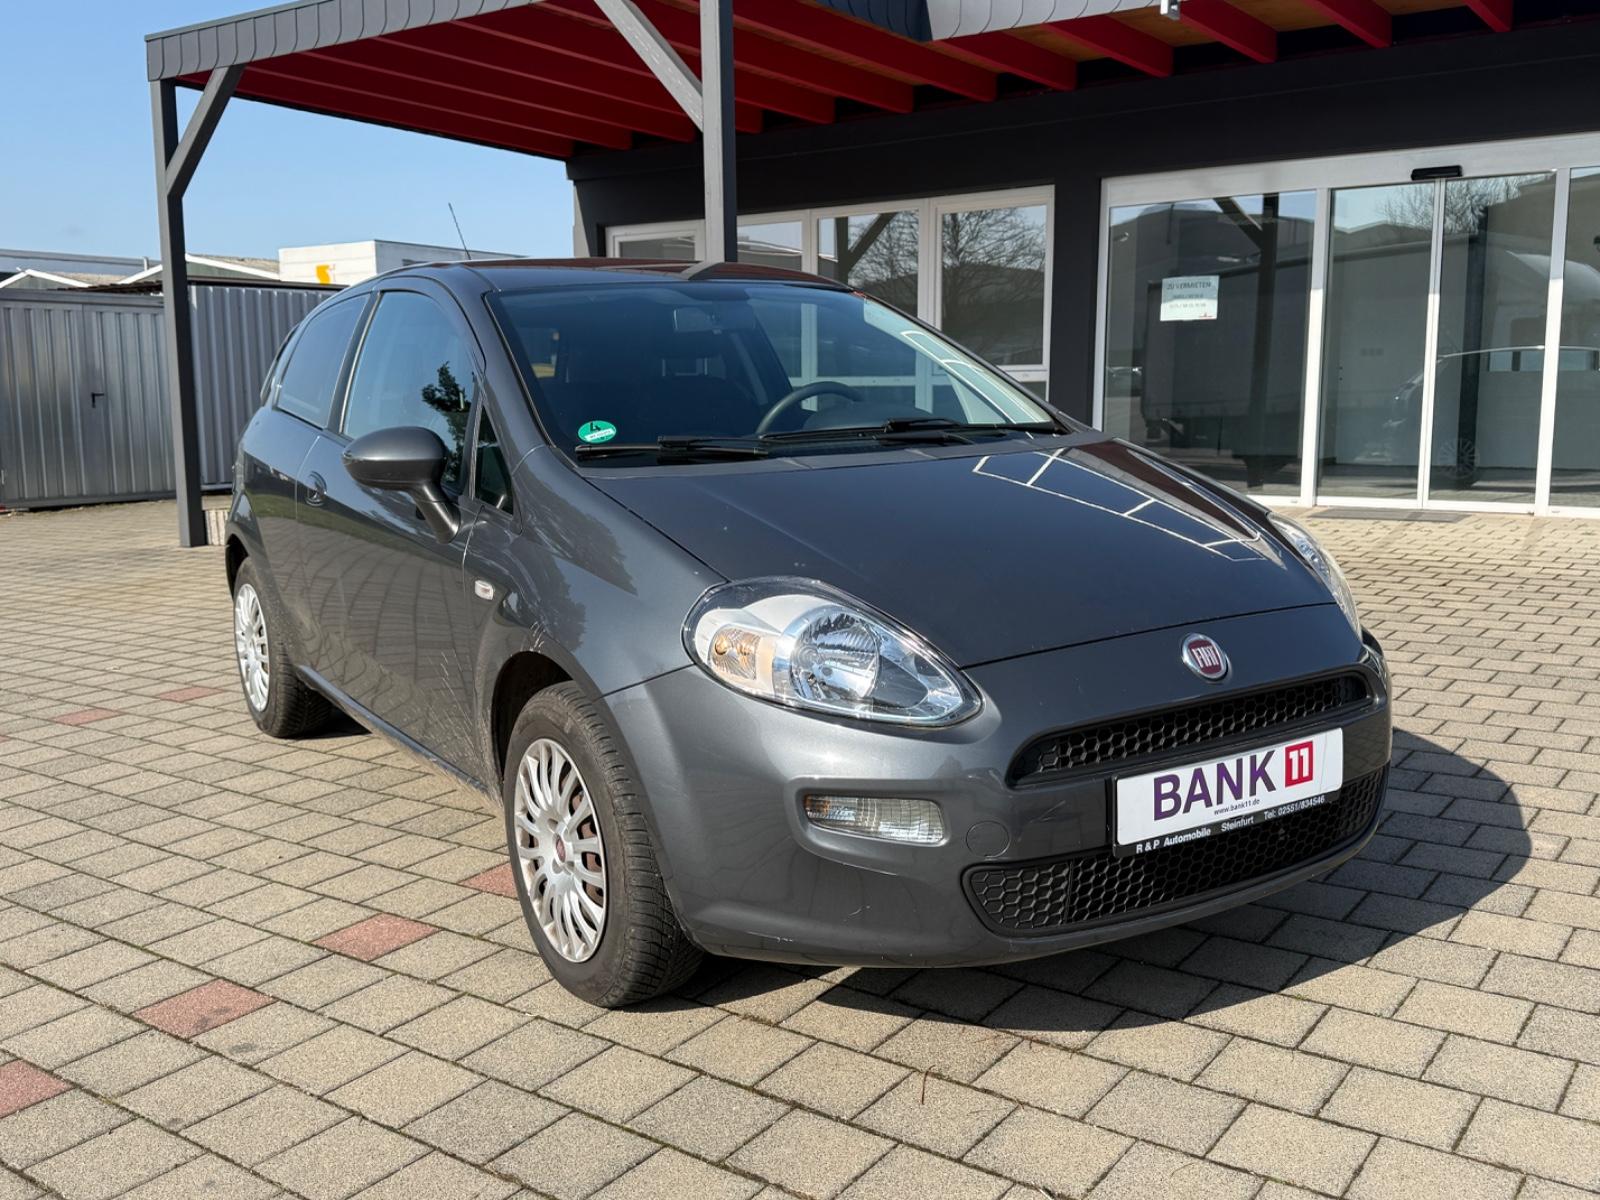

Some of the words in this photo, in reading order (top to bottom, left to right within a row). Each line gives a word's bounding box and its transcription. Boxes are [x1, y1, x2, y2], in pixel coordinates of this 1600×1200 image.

[1176, 281, 1212, 289] VERMIETEN
[1191, 645, 1219, 668] FIAT
[1153, 750, 1276, 821] BANK
[1288, 747, 1310, 781] 11
[1213, 798, 1261, 816] www.bank11.de
[1136, 844, 1143, 854] R
[1144, 842, 1152, 852] &
[1153, 840, 1160, 850] P
[1163, 827, 1212, 847] Automobile
[1221, 816, 1254, 832] Steinfurt
